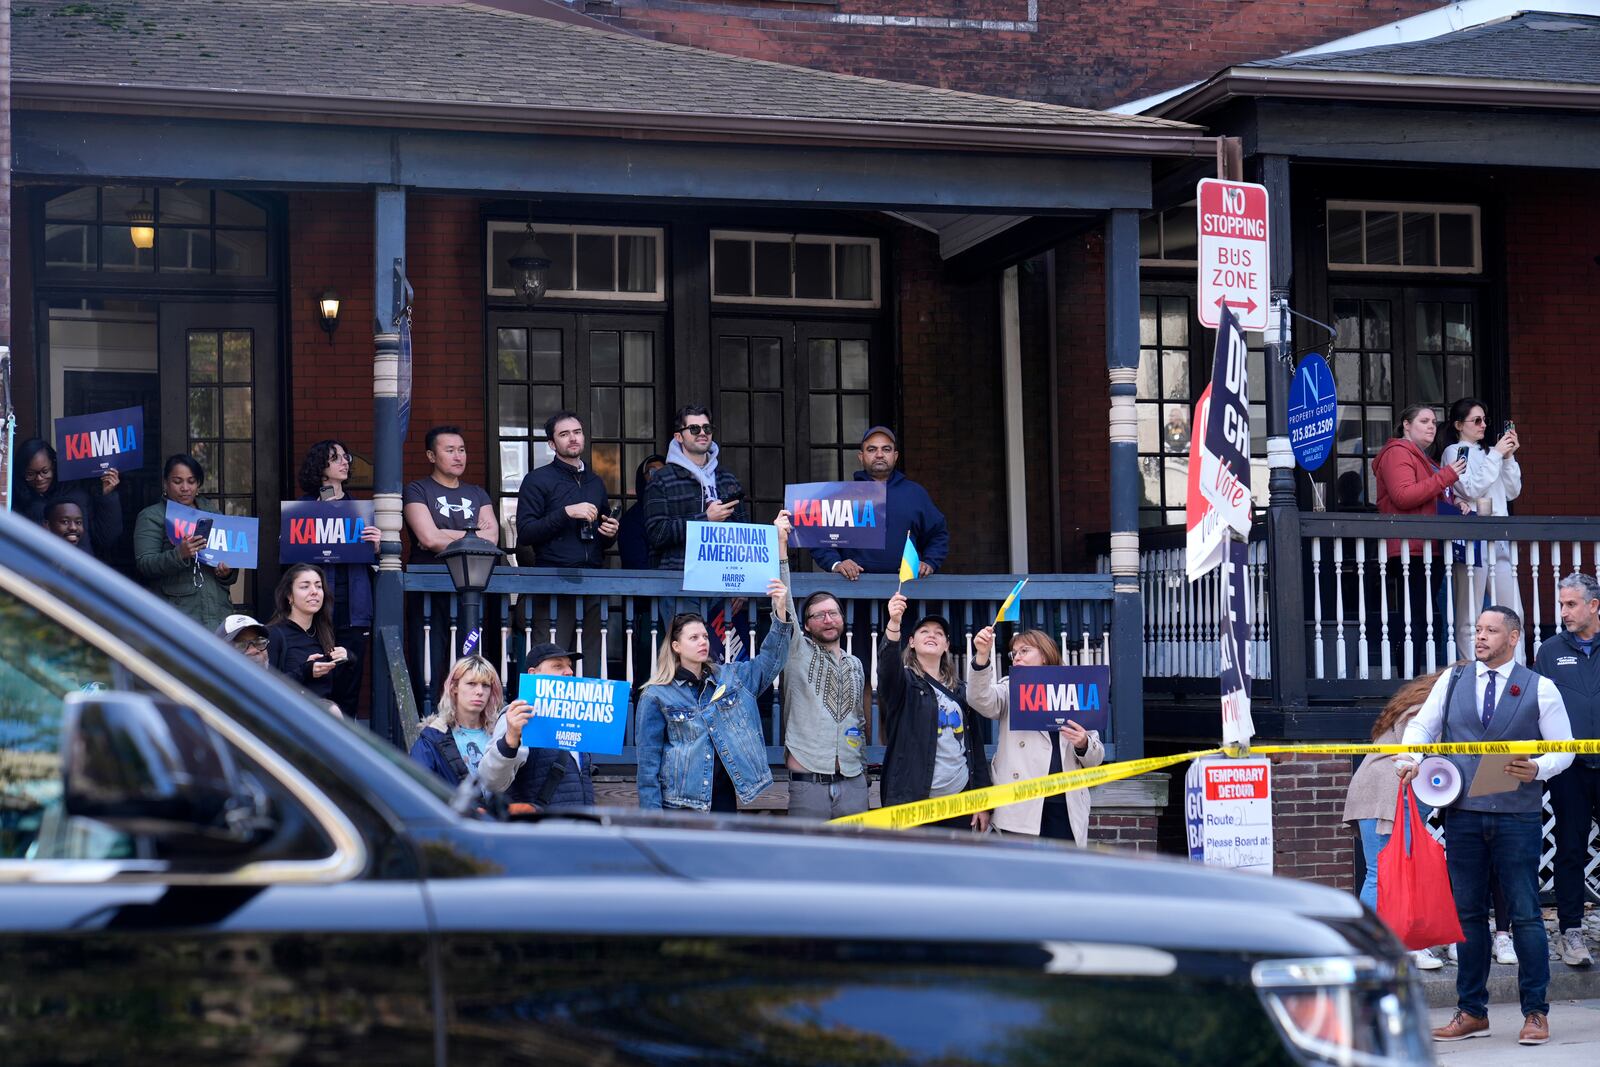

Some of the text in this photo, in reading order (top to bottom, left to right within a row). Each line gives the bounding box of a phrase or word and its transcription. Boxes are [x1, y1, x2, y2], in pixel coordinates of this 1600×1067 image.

[1221, 186, 1246, 215] NO
[1203, 213, 1265, 238] STOPPING
[1218, 247, 1252, 267] BUS
[1212, 269, 1258, 289] ZONE
[1302, 362, 1319, 409] N
[1289, 402, 1335, 425] PROPERTY GROUP
[1291, 417, 1334, 443] 215.825.2509
[65, 425, 136, 461] KAMALA
[1302, 444, 1324, 457] APARTMENTS
[1304, 453, 1322, 464] AVAILABLE
[1215, 455, 1244, 508] Vote
[793, 499, 876, 528] KAMALA
[290, 517, 366, 545] KAMALA
[701, 526, 767, 546] UKRAINIAN
[697, 544, 770, 563] AMERICANS
[722, 573, 745, 583] HARRIS
[535, 679, 615, 704] UKRAINIAN
[1019, 683, 1100, 712] KAMALA
[533, 698, 615, 724] AMERICANS
[555, 731, 582, 742] HARRIS
[558, 740, 577, 748] WALZ
[1207, 768, 1264, 783] TEMPORARY
[1218, 784, 1254, 799] DETOUR
[1206, 814, 1234, 826] Route
[1206, 836, 1271, 848] Please Board at:
